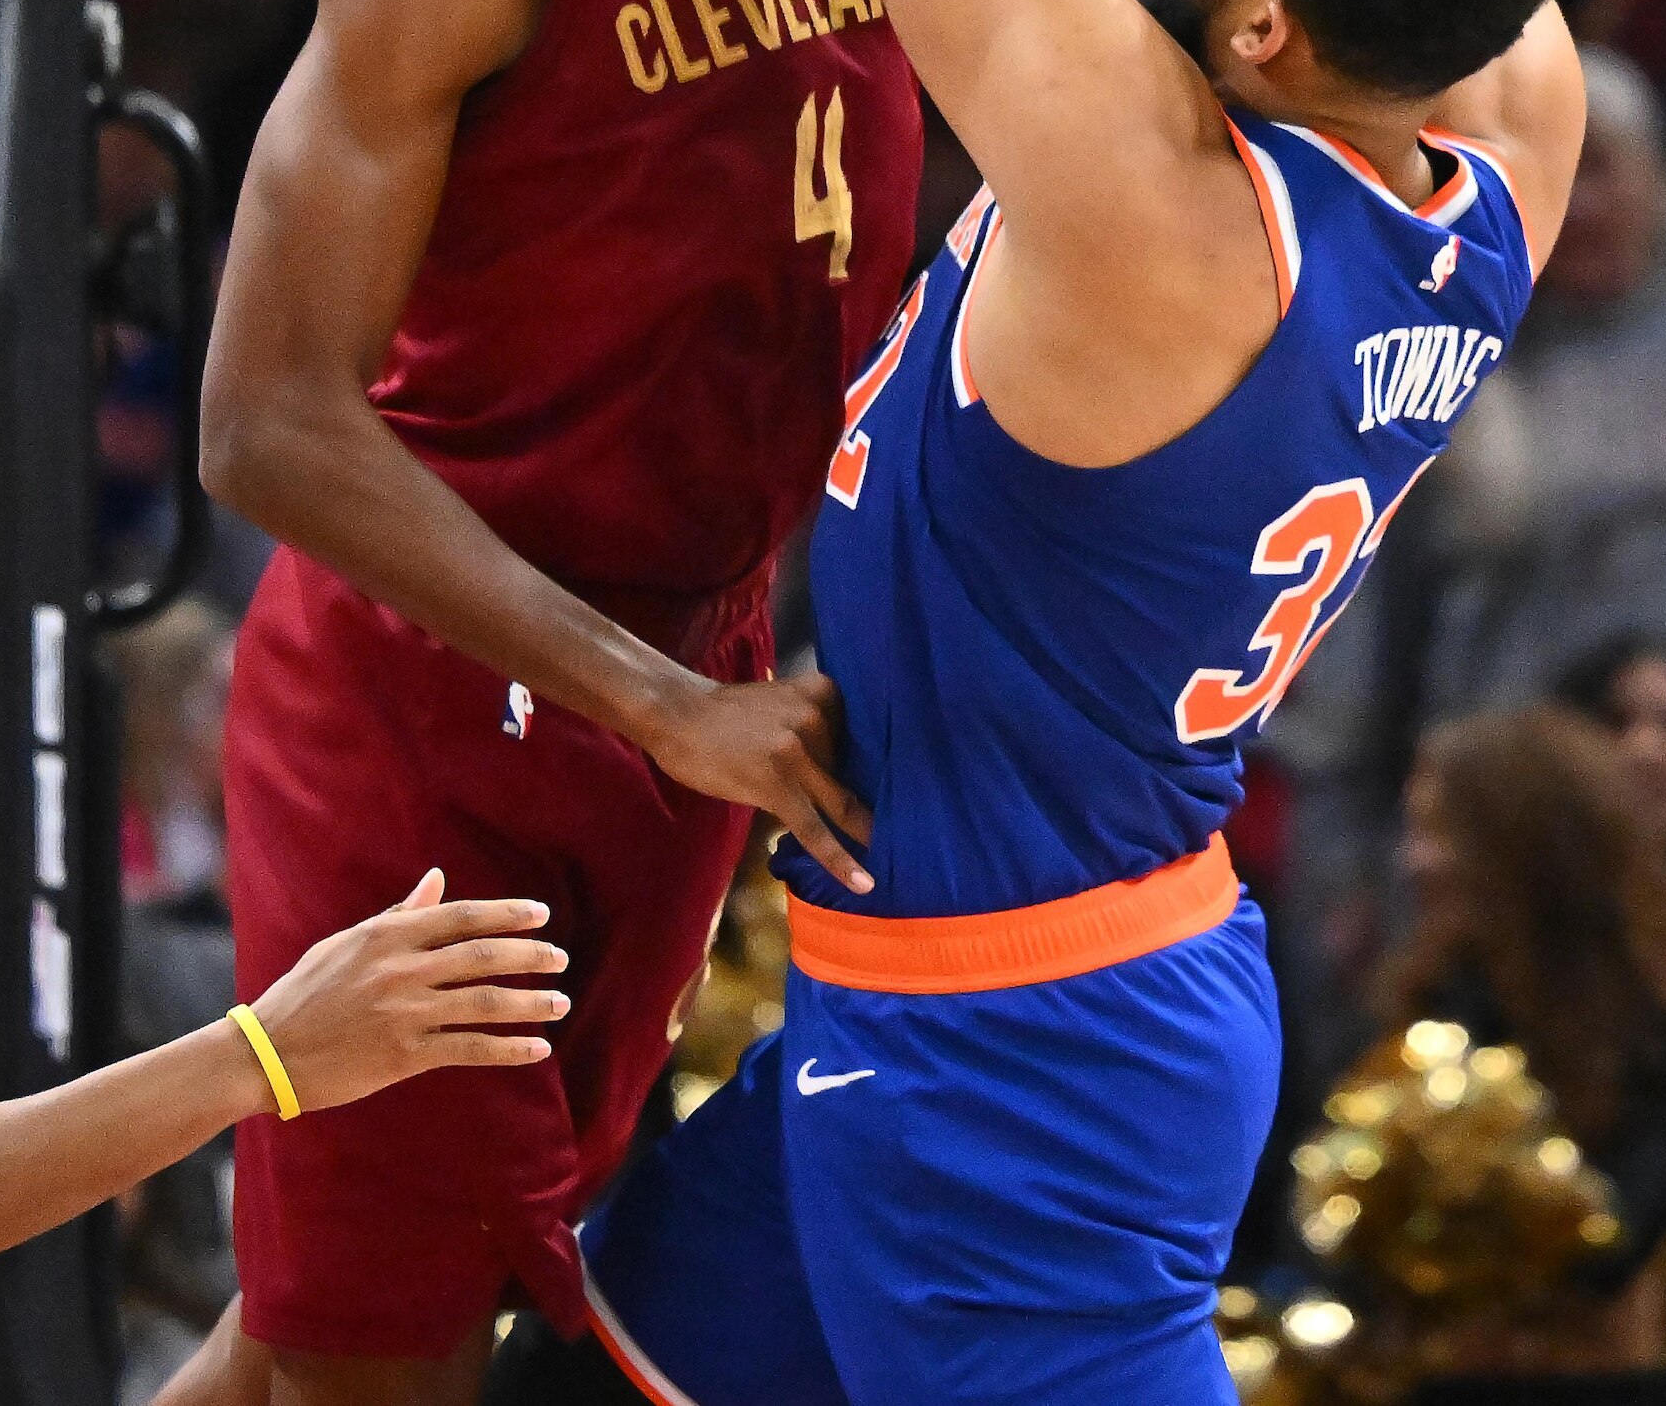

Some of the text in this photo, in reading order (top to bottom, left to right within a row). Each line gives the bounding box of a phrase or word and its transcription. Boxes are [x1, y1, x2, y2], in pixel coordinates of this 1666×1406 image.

[793, 85, 852, 278] 4
[826, 270, 929, 510] 2
[1354, 325, 1503, 433] TOWNS
[1174, 456, 1436, 744] 3
